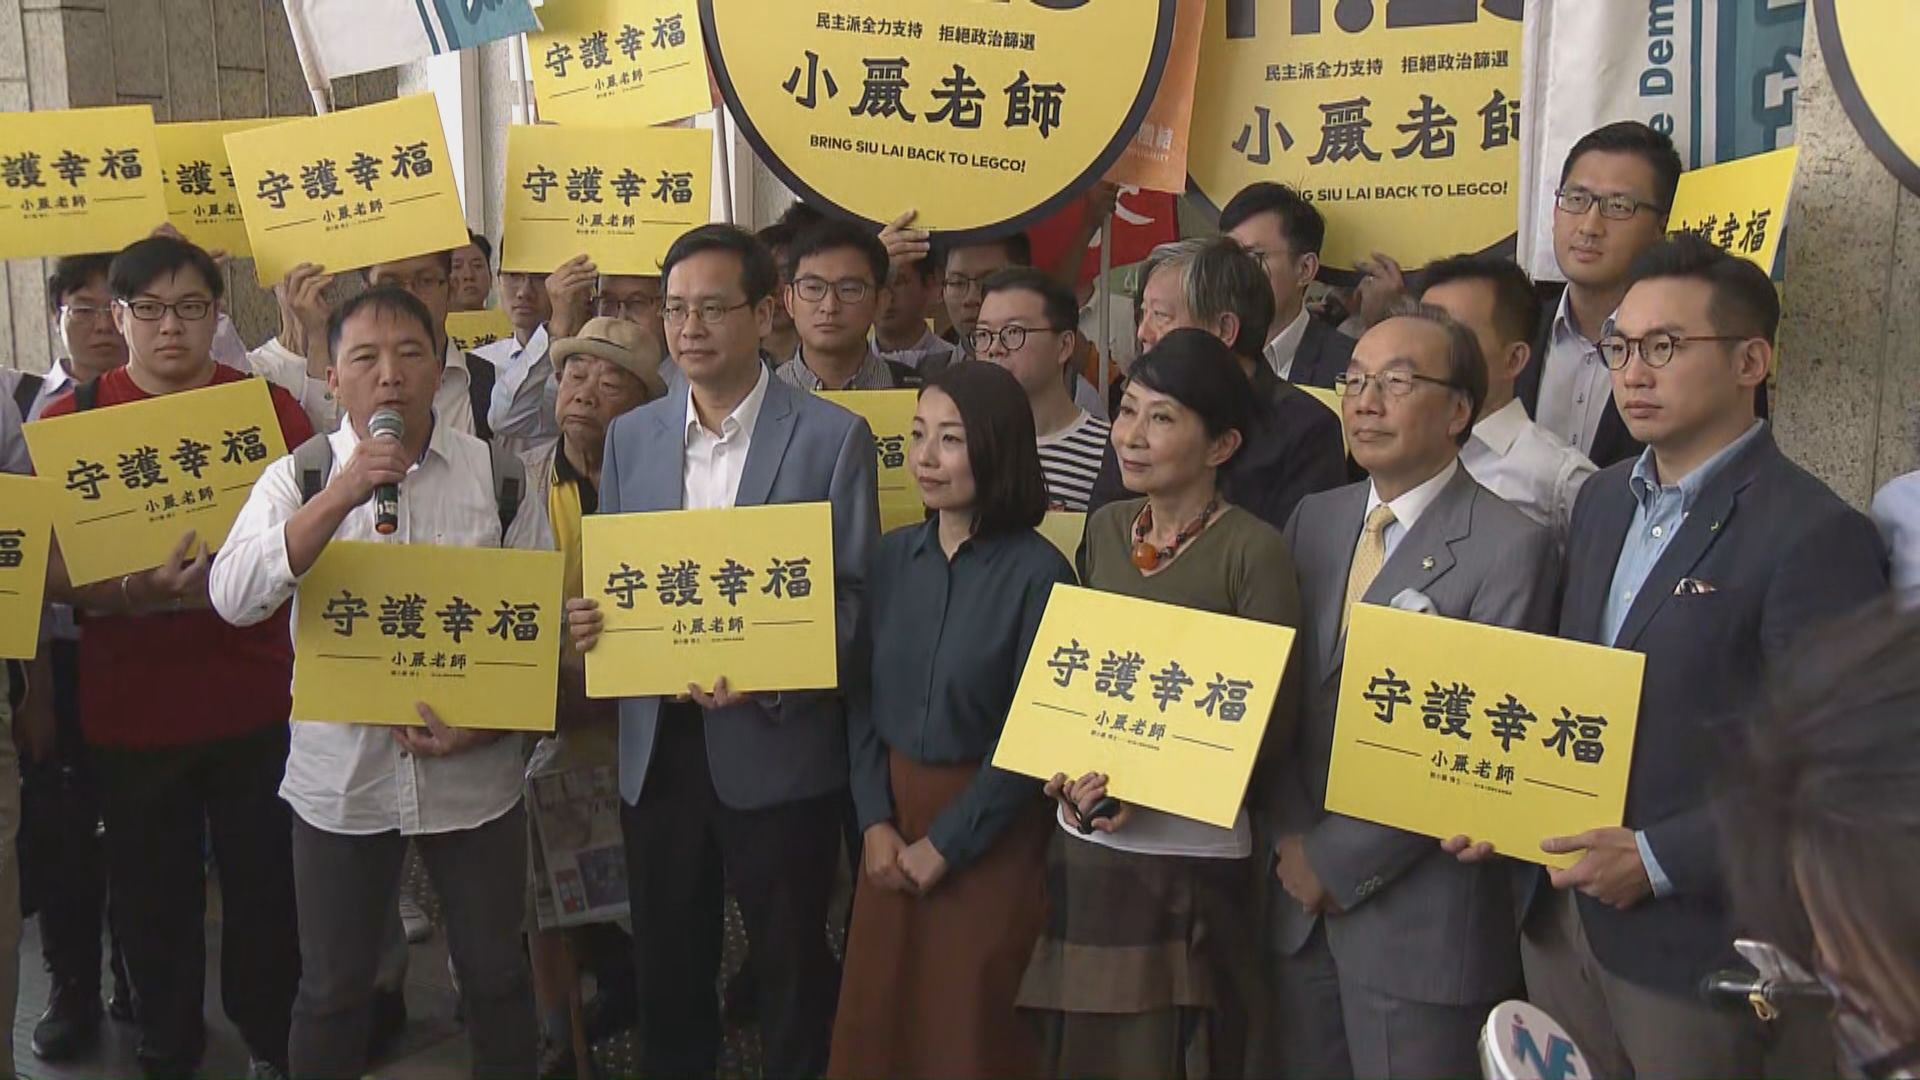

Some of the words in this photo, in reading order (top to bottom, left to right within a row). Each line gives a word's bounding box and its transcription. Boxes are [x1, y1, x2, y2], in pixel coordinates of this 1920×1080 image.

[544, 12, 687, 78] 守護幸福
[816, 12, 923, 39] 民主派全力支持
[1265, 58, 1383, 82] 民主派全力支持
[1401, 50, 1509, 74] 拒絕政治篩選
[782, 50, 1067, 140] 小麗老師
[810, 134, 852, 151] BRING
[855, 140, 878, 154] SIU
[881, 144, 904, 158] LAI
[907, 146, 945, 163] BACK
[949, 152, 969, 165] TO
[971, 154, 1026, 173] LEGCO!
[256, 141, 434, 209] 守護幸福
[521, 164, 694, 206] 守護幸福
[1317, 187, 1343, 202] SIU
[1346, 187, 1371, 200] LAI
[1375, 185, 1418, 199] BACK
[1421, 184, 1444, 198] TO
[1447, 181, 1508, 197] LEGCO!
[65, 425, 268, 500] 守護幸福
[144, 488, 215, 513] 小麗老師
[603, 556, 812, 608] 守護幸福
[320, 588, 541, 643] 守護幸福
[672, 616, 744, 635] 小麗老師
[391, 651, 467, 670] 小麗老師
[1046, 638, 1255, 723] 守護幸福
[1094, 710, 1167, 741] 小麗老師
[1362, 667, 1609, 765] 守護幸福
[1431, 750, 1515, 785] 小麗老師
